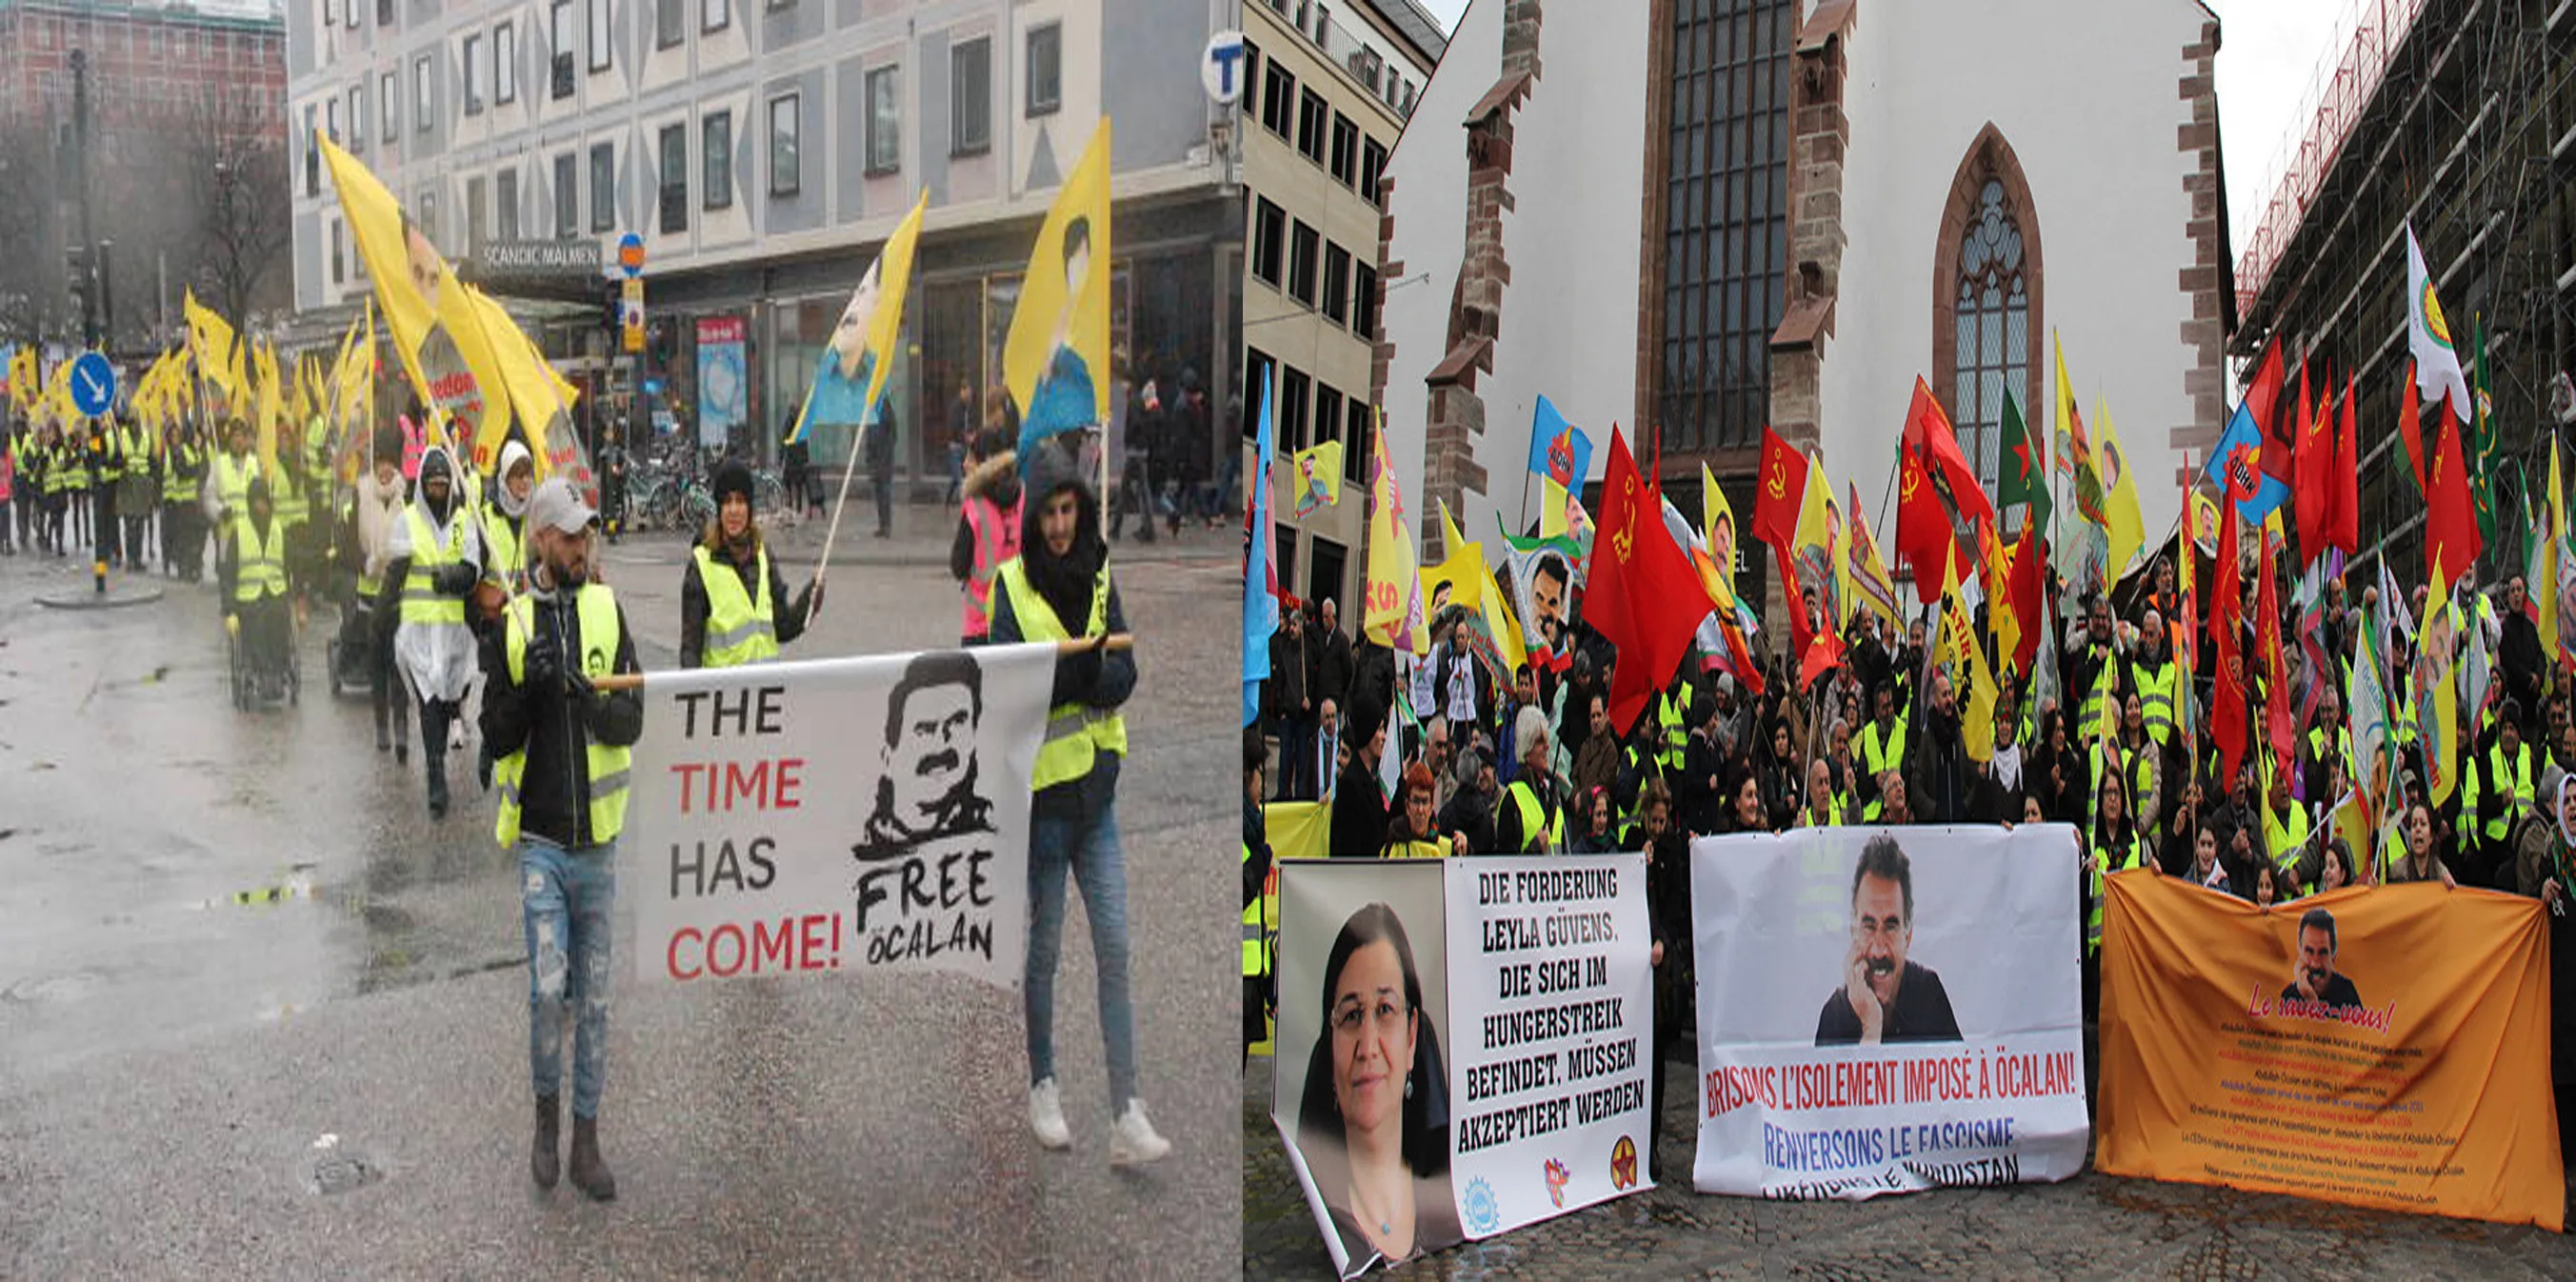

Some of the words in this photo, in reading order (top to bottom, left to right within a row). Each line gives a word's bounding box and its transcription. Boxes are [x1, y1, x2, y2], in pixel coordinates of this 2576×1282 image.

[1211, 44, 1242, 94] T
[484, 244, 537, 267] SCANDIC
[675, 687, 786, 737] THE
[670, 759, 804, 813] TIME
[670, 837, 777, 898] HAS
[856, 850, 994, 934] FREE
[1479, 871, 1510, 906] DIE
[1519, 868, 1618, 904] FORDERUNG
[667, 912, 841, 980] COME!
[868, 912, 992, 964] ÖCALAN
[1483, 918, 1539, 953] LEYLA
[1499, 963, 1531, 999] DIE
[1538, 959, 1580, 992] SICH
[1586, 955, 1608, 987] IM
[1483, 997, 1624, 1050] HUNGERSTREIK
[2248, 982, 2272, 1018] Le
[2278, 999, 2397, 1035] savez-vous!
[1568, 1037, 1637, 1081] MÜSSEN
[1707, 1065, 1777, 1118] BRISONS
[1782, 1059, 1899, 1112] L'ISOLEMENT
[1904, 1049, 1973, 1105] IMPOSÉ
[1979, 1049, 1991, 1099] À
[1995, 1045, 2076, 1099] ÖCALAN!
[1457, 1095, 1570, 1155] AKZEPTIERT
[1574, 1078, 1646, 1126] WERDEN
[1764, 1121, 1884, 1172] RENVERSONS
[1890, 1126, 1911, 1159] LE
[1919, 1116, 2014, 1152] FASCISME
